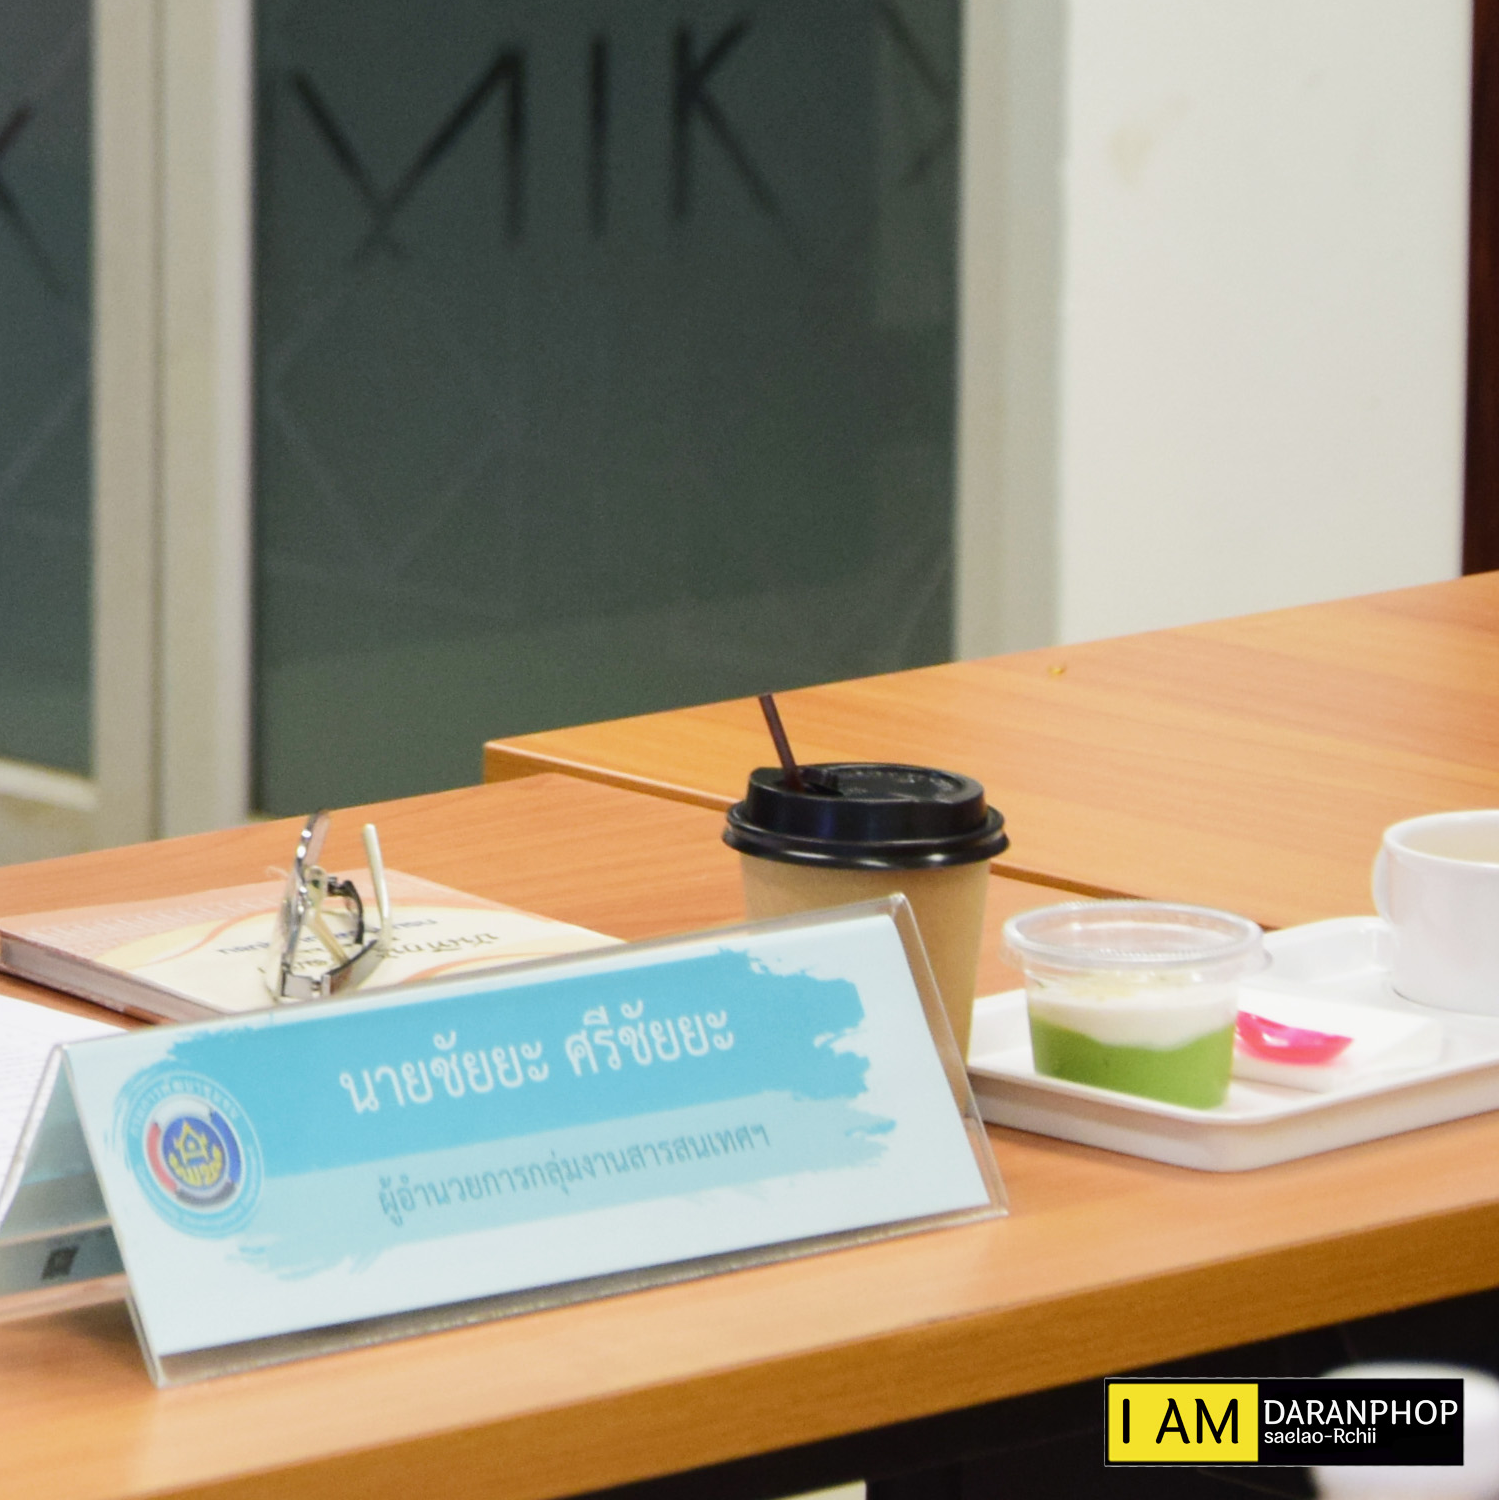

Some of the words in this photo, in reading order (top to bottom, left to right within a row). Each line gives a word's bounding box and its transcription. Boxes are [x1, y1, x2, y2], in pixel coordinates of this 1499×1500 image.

[339, 1030, 549, 1114] นายชัยยะ
[564, 999, 735, 1077] ศรีชัยยะ
[377, 1123, 771, 1227] ผู้อำนวยการกลุ่มงานสารสนเทศฯ
